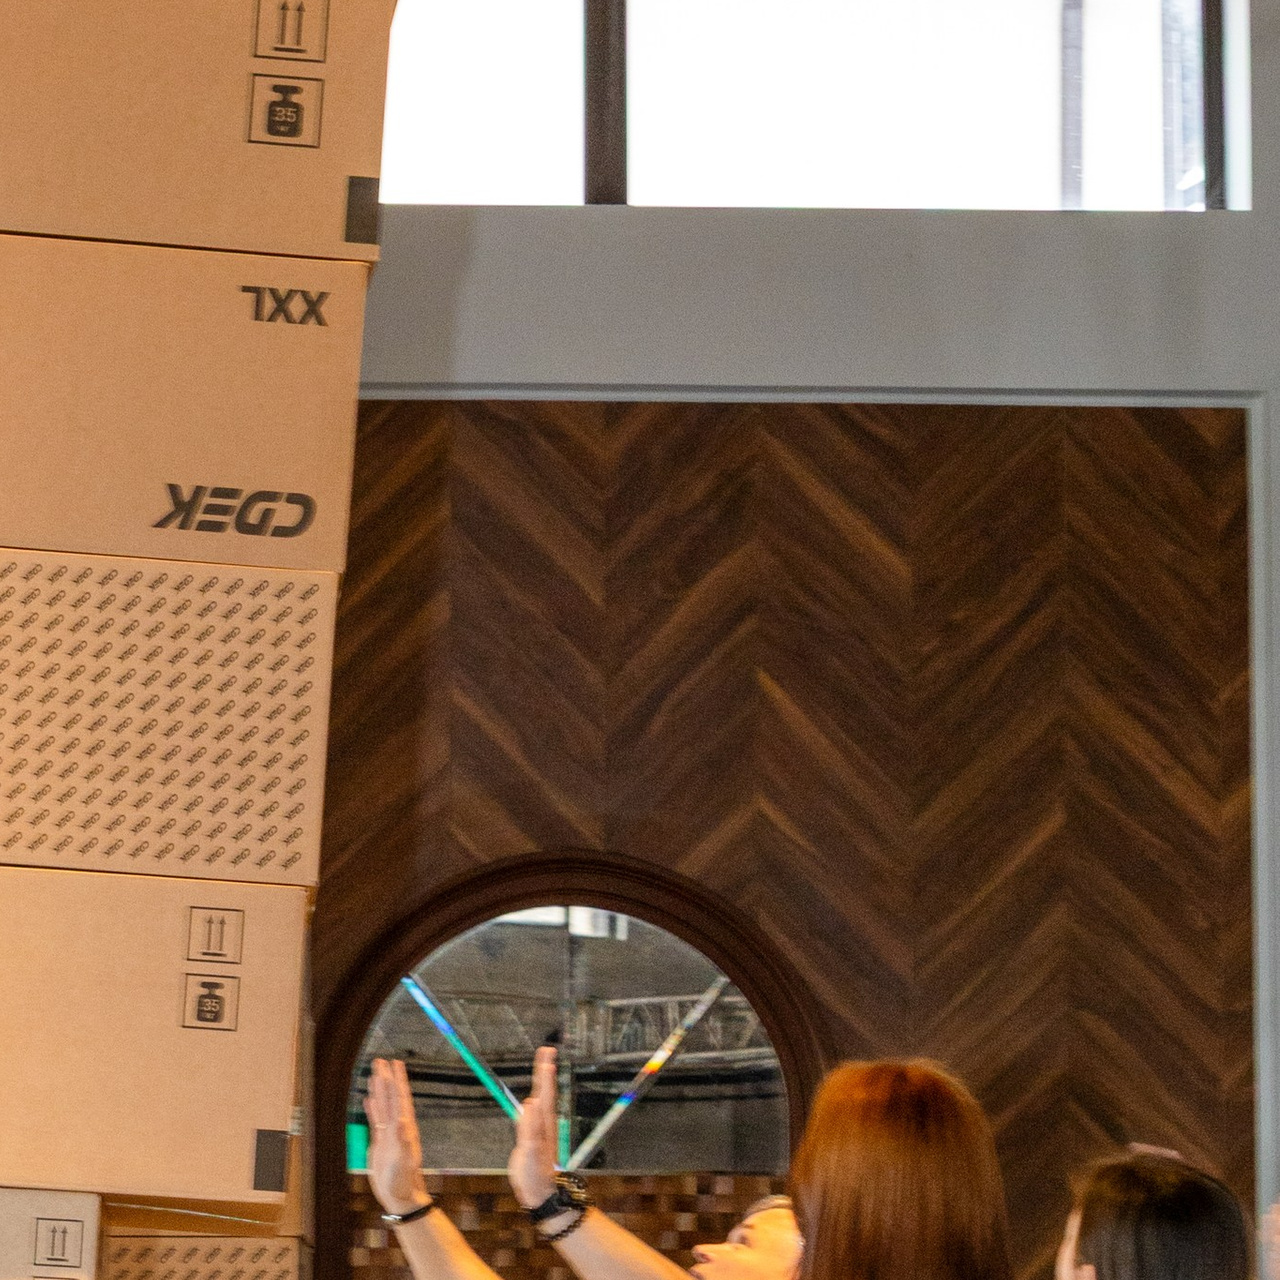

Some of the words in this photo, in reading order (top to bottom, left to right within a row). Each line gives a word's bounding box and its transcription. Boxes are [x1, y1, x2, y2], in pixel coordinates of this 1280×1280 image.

[275, 107, 297, 122] 35
[241, 286, 329, 326] XXL
[152, 483, 316, 538] CDEK
[204, 999, 220, 1011] 35
